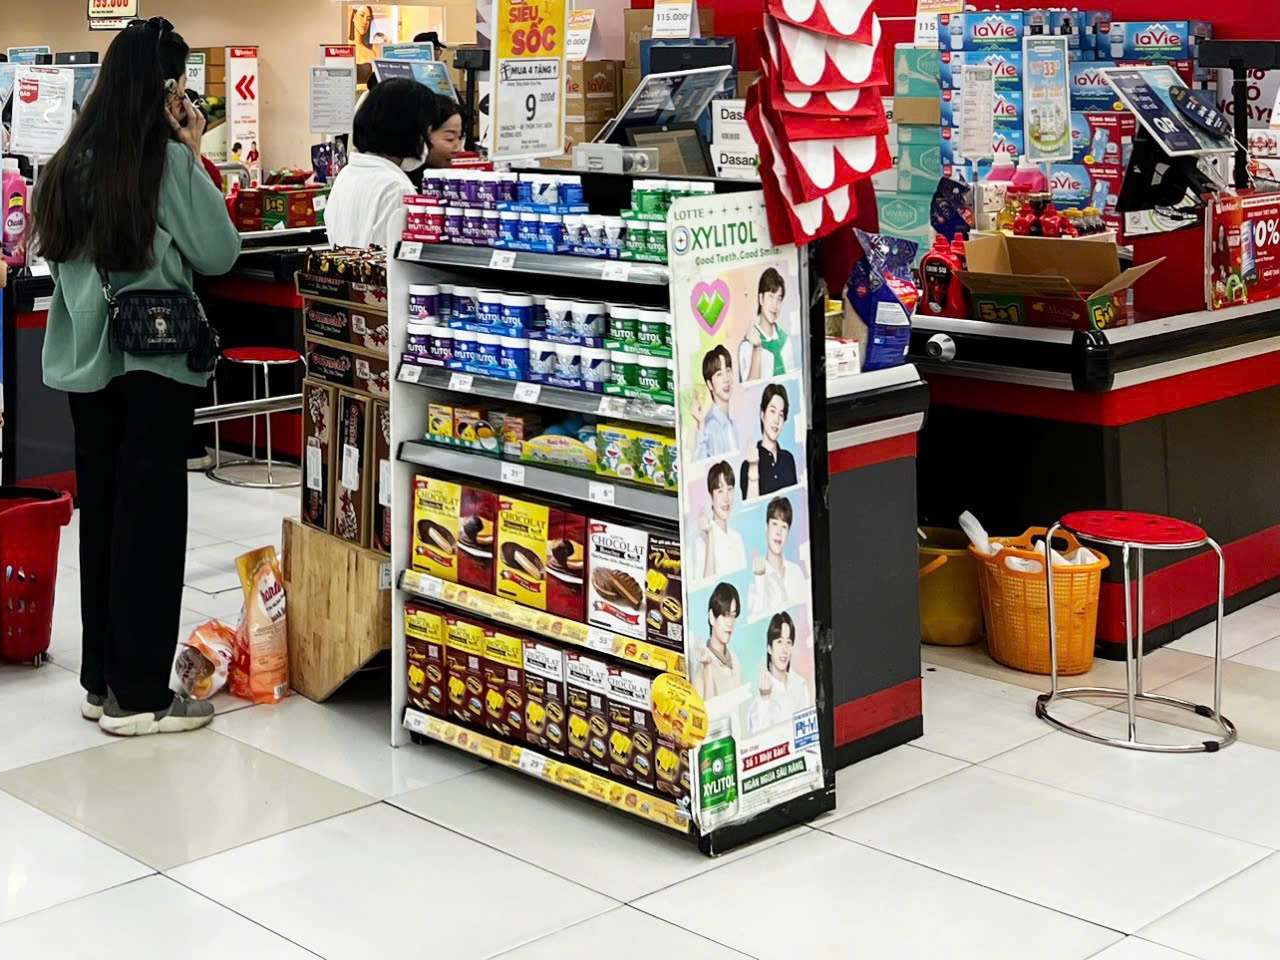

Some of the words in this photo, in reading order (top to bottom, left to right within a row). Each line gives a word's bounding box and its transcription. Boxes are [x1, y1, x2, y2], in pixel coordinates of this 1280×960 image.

[509, 1, 539, 24] SIÊU
[511, 16, 557, 55] SỐC
[973, 22, 1017, 37] laVie
[1135, 30, 1181, 45] laVie
[511, 66, 527, 74] MUA
[528, 66, 533, 74] 4
[988, 62, 1017, 75] Vie
[525, 93, 536, 121] 9
[993, 101, 1017, 116] Vie
[1153, 116, 1180, 134] QR
[992, 141, 1017, 155] Vie
[1049, 177, 1081, 190] aVie
[674, 208, 705, 221] LOTTE
[690, 221, 757, 251] XYLITOL
[1253, 218, 1280, 248] 0%
[695, 254, 715, 266] Good
[740, 248, 759, 261] Good
[979, 301, 1020, 324] 5+1
[500, 511, 546, 529] CHOCOLAT
[592, 535, 645, 555] CHOCOLAT
[608, 677, 648, 693] CHOCOLAT
[703, 773, 736, 798] XYLITOL
